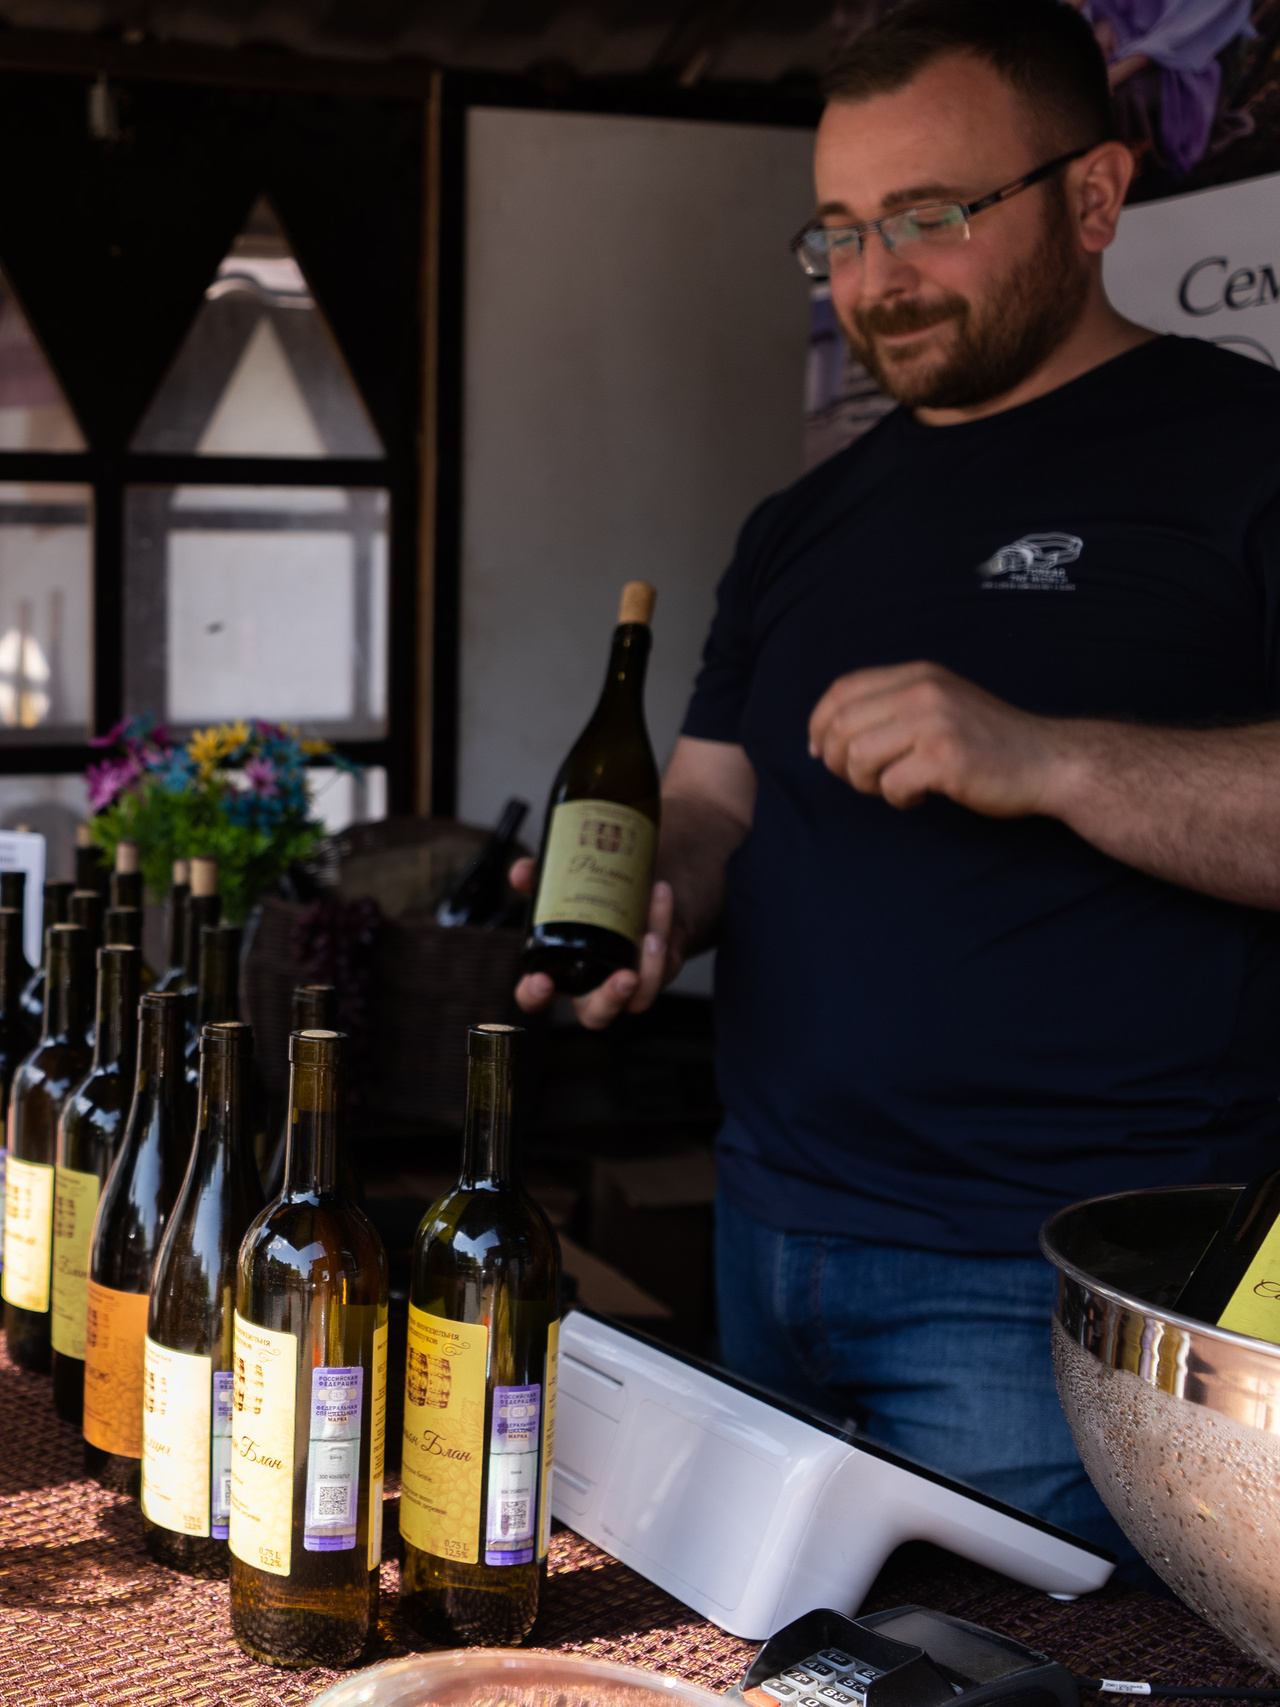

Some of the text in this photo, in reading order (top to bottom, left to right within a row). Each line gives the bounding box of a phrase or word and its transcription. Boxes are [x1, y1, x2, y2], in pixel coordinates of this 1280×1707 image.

[421, 1430, 472, 1461] Блан
[240, 1435, 283, 1470] Блан
[444, 1539, 469, 1551] 0,75 L
[259, 1547, 274, 1557] 0,75
[444, 1548, 469, 1560] 12,5%
[260, 1556, 281, 1568] 12,2%
